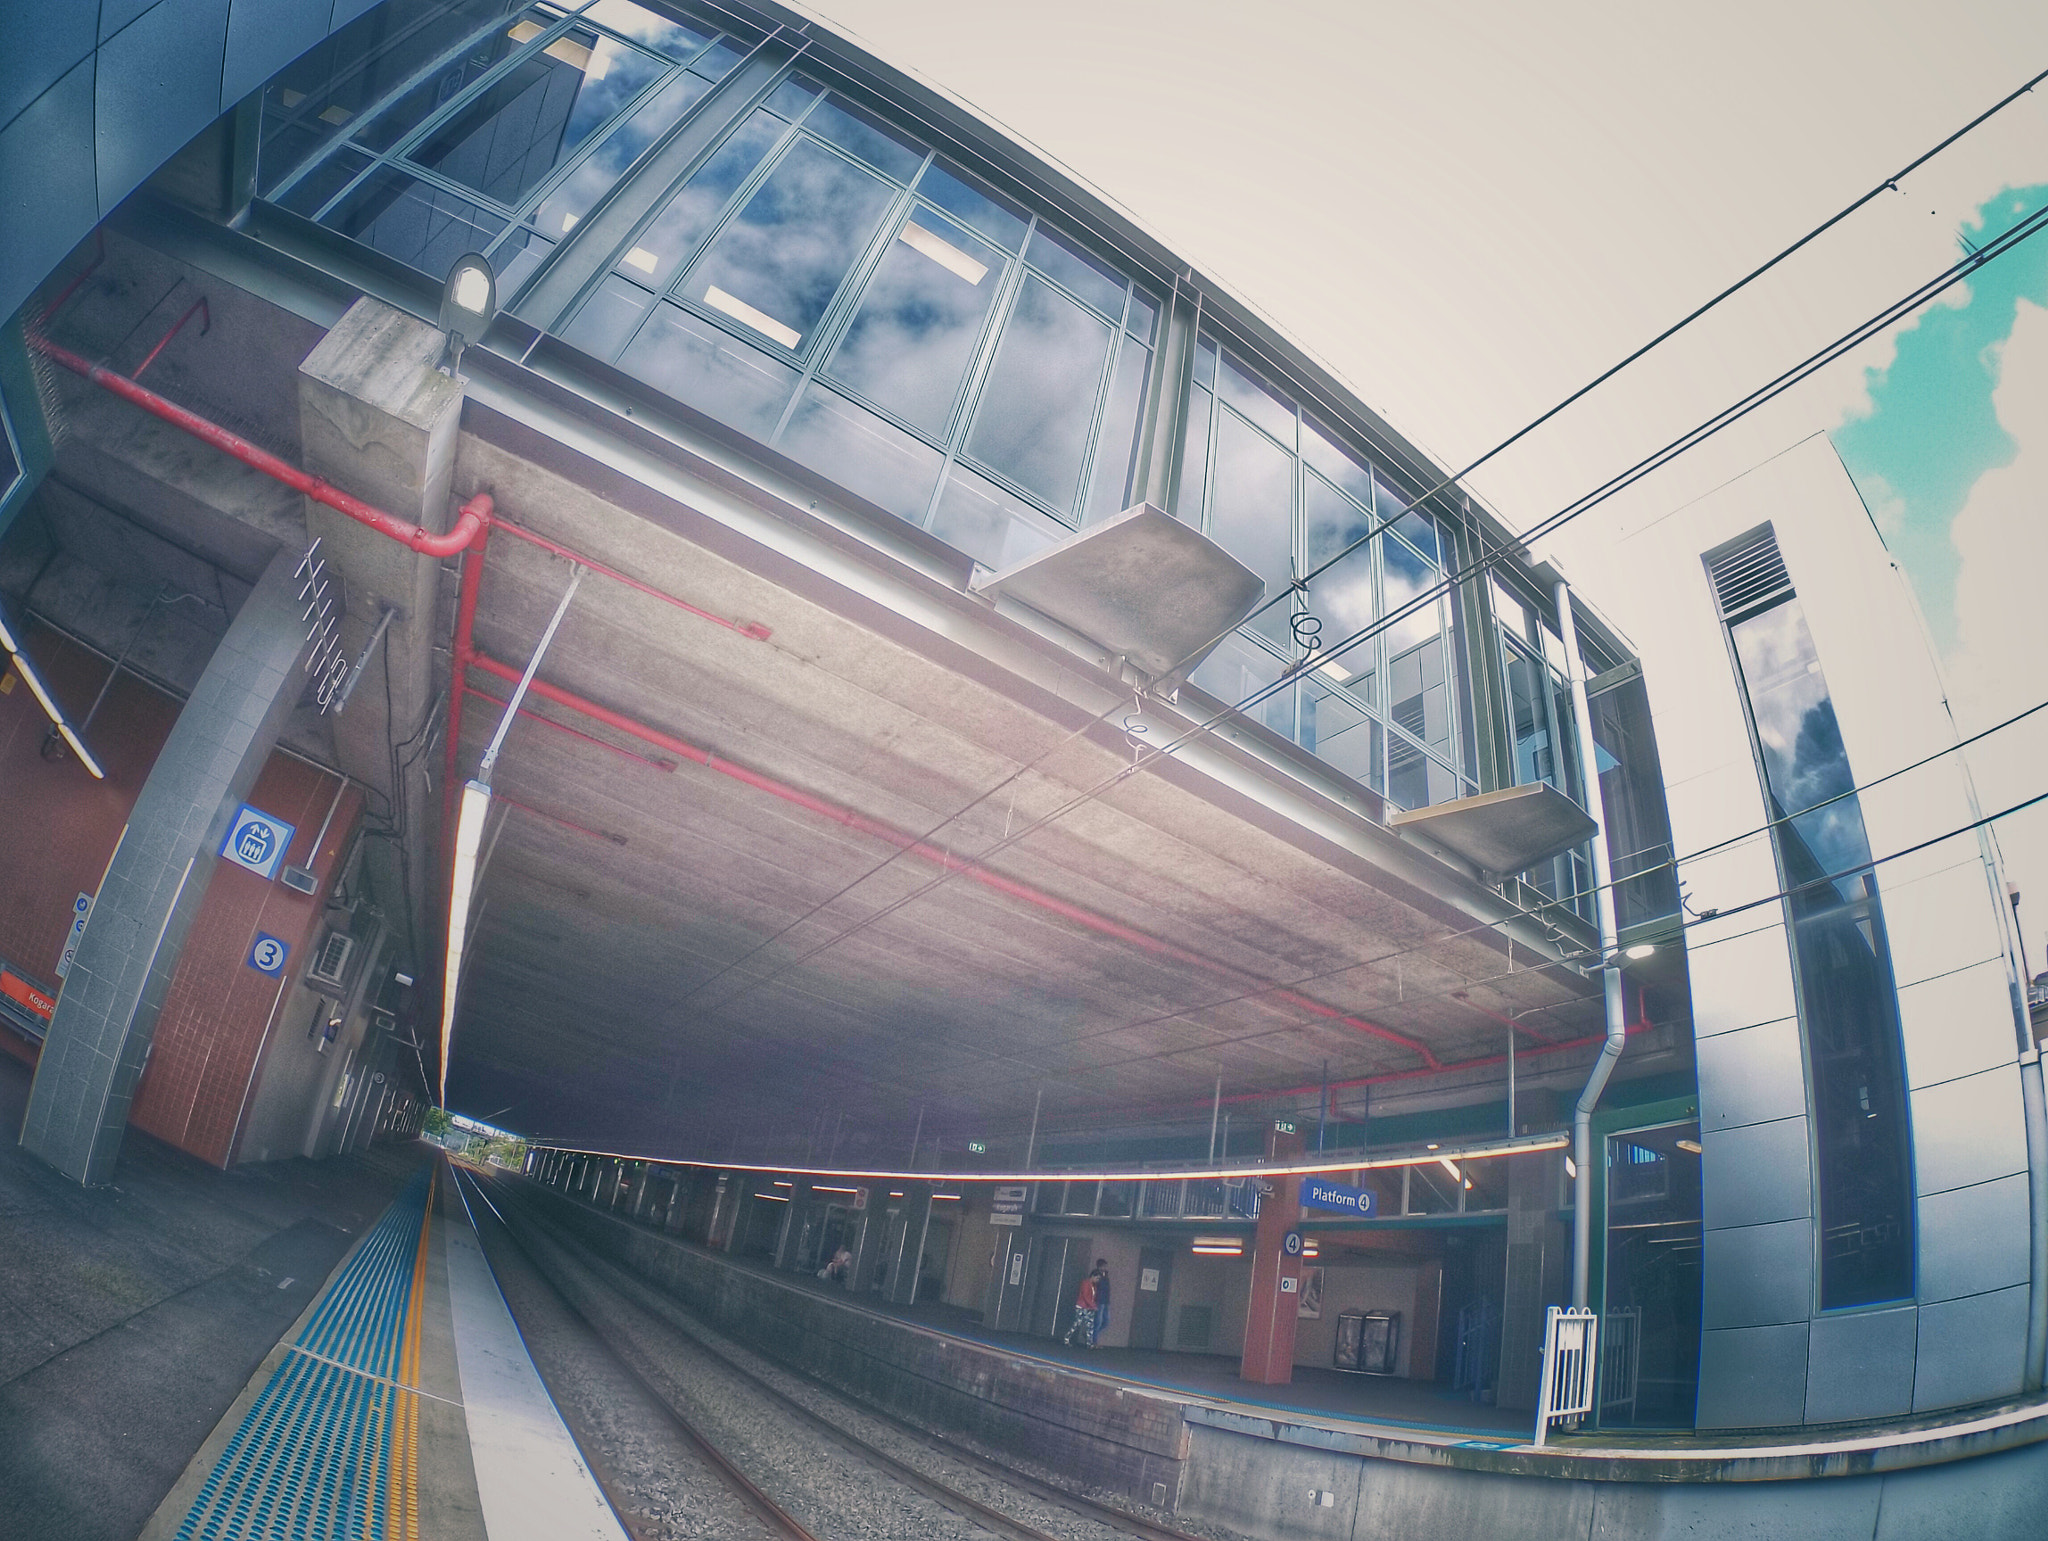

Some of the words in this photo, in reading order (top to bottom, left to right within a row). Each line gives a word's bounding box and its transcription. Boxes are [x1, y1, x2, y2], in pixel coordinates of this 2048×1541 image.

[259, 943, 277, 966] 3
[1312, 1187, 1355, 1207] Platform
[1289, 1236, 1297, 1251] 4
